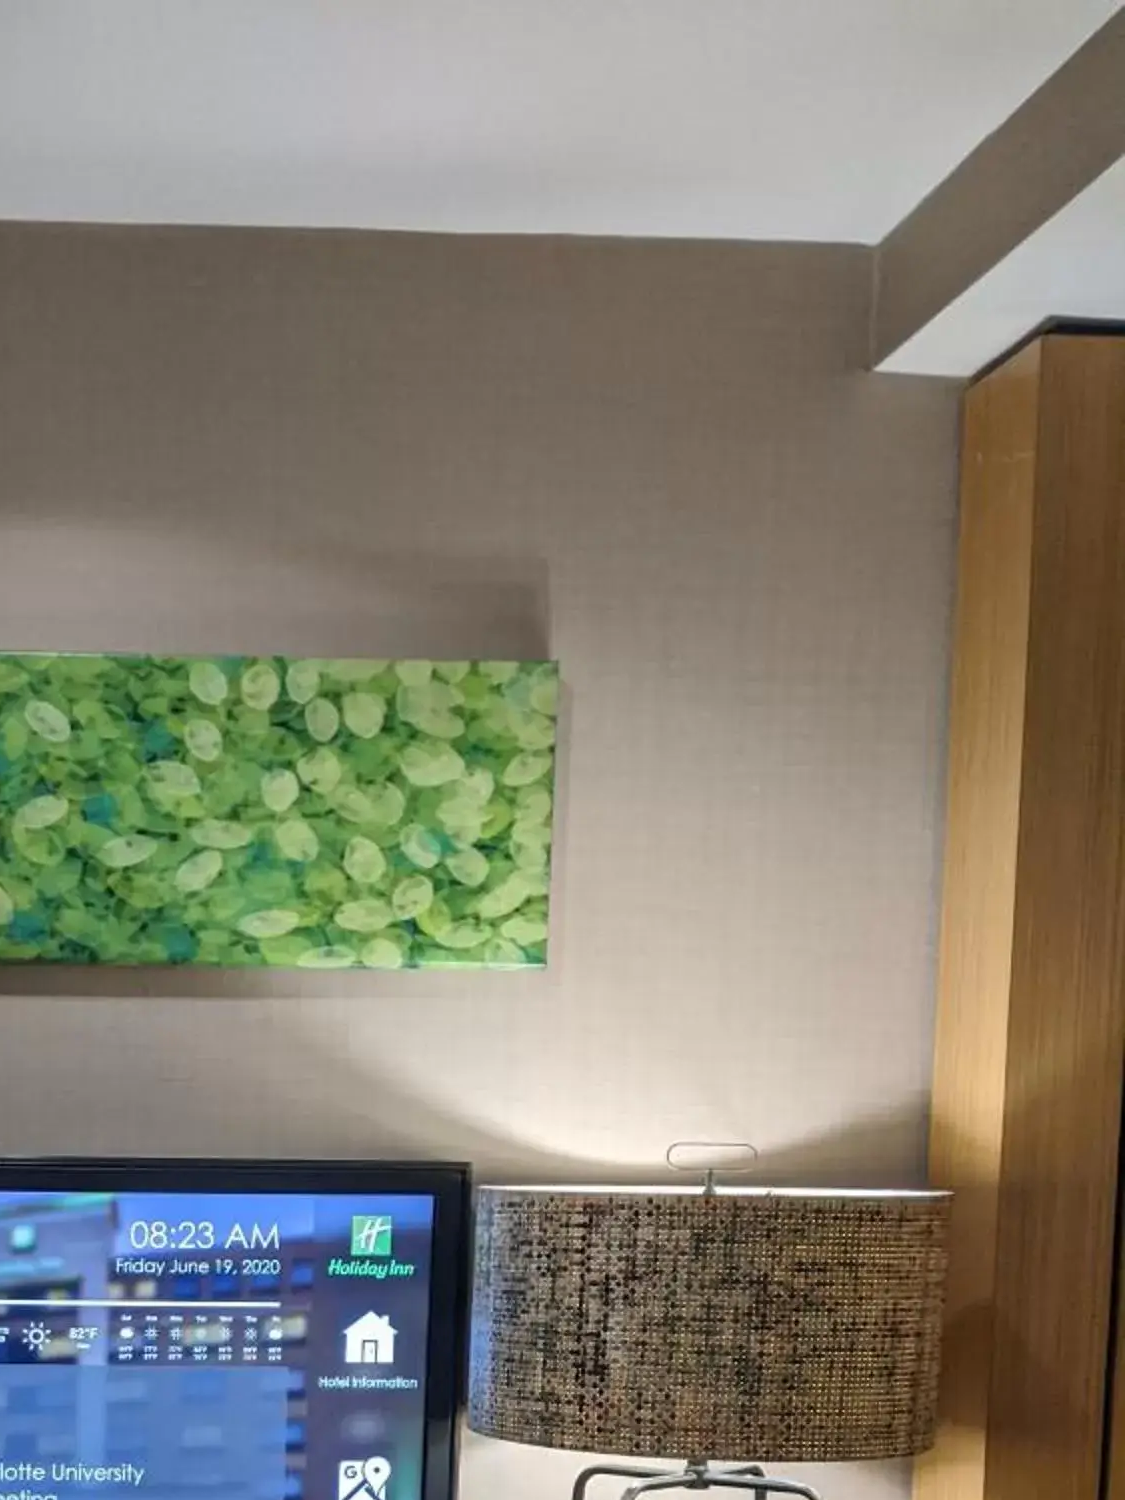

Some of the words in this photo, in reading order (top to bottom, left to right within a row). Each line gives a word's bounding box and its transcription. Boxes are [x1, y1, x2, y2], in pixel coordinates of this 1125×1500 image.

[129, 1220, 215, 1250] 08:23
[225, 1222, 280, 1250] AM
[115, 1258, 165, 1276] Friday
[169, 1259, 210, 1274] June
[215, 1260, 238, 1275] 19,
[242, 1259, 281, 1275] 2020
[328, 1259, 388, 1279] Holiday
[389, 1260, 415, 1276] Inn
[318, 1376, 350, 1389] Hotel
[352, 1376, 418, 1389] Information
[52, 1463, 145, 1487] University
